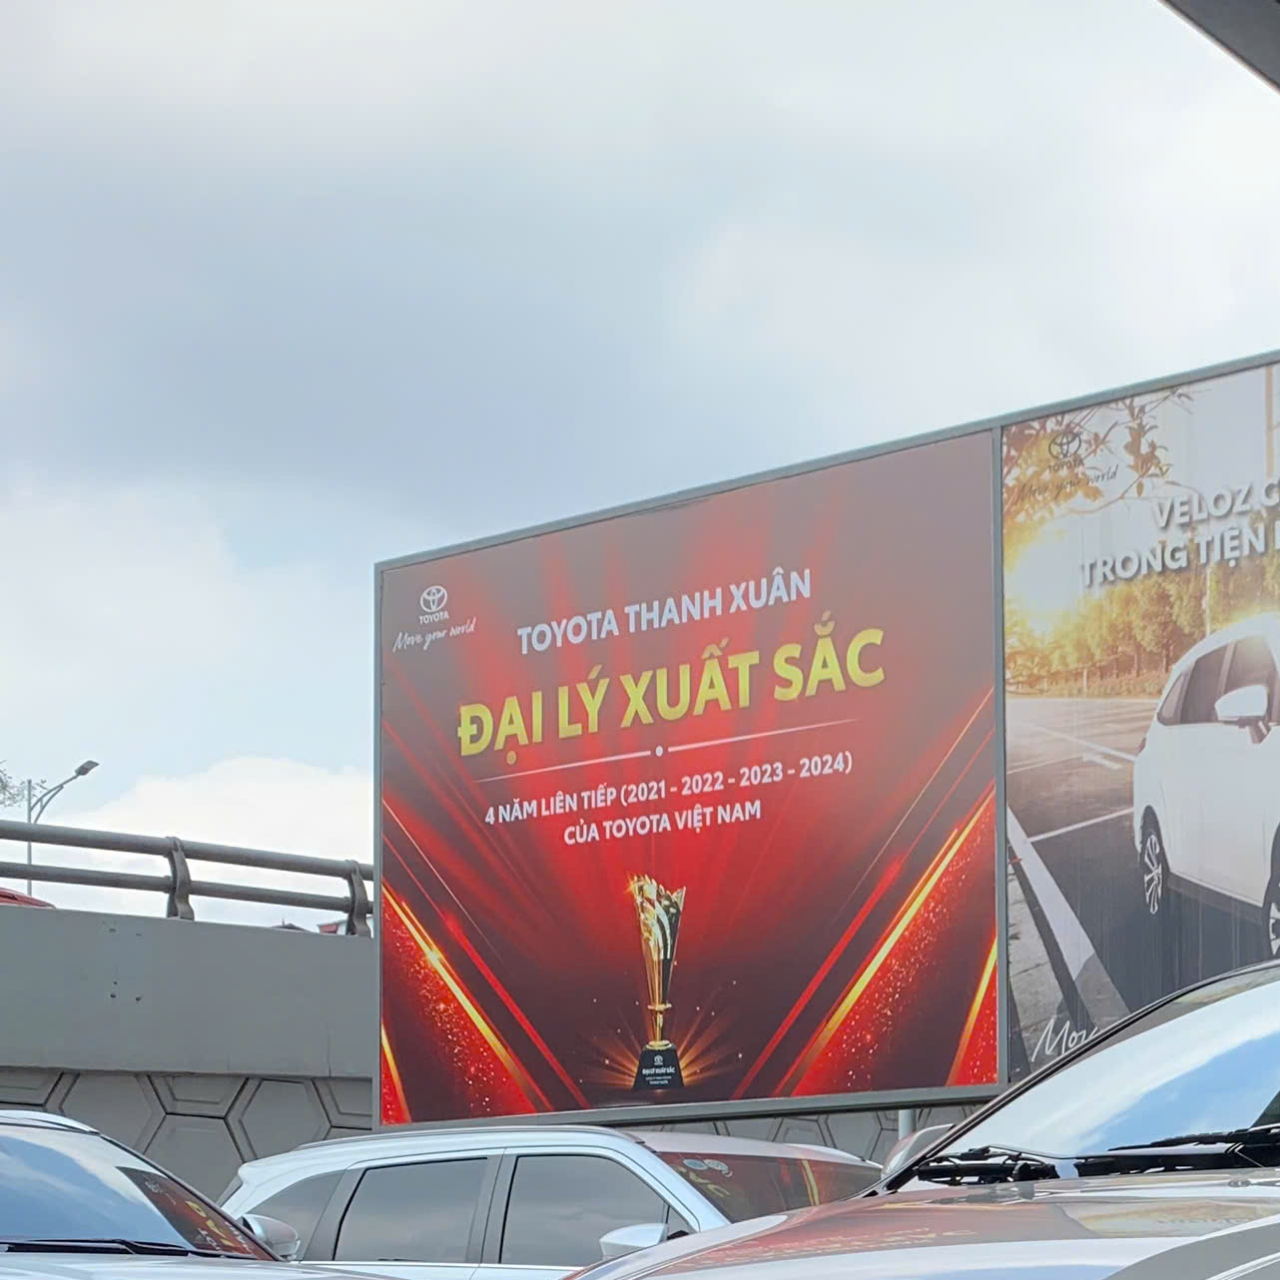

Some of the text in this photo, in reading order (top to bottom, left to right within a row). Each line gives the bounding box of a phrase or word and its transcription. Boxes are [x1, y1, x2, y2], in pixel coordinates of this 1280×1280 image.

[1151, 482, 1252, 529] VELOZ
[1081, 538, 1188, 587] TRONG
[1194, 523, 1266, 567] TIỆN
[419, 611, 449, 624] TOYOTA
[518, 566, 811, 654] TOYOTA THANH XUÂN
[392, 632, 423, 653] Move
[457, 610, 885, 765] ĐẠI LÝ XUẤT SẮC
[485, 807, 495, 824] 4
[498, 798, 537, 823] NĂM
[541, 791, 577, 816] LIÊN
[581, 782, 616, 810] TIẾP
[621, 780, 666, 807] (2021
[681, 771, 724, 795] 2022
[740, 762, 783, 787] 2023
[799, 751, 852, 778] 2024)
[564, 800, 761, 845] CỦA TOYOTA VIỆT NAM
